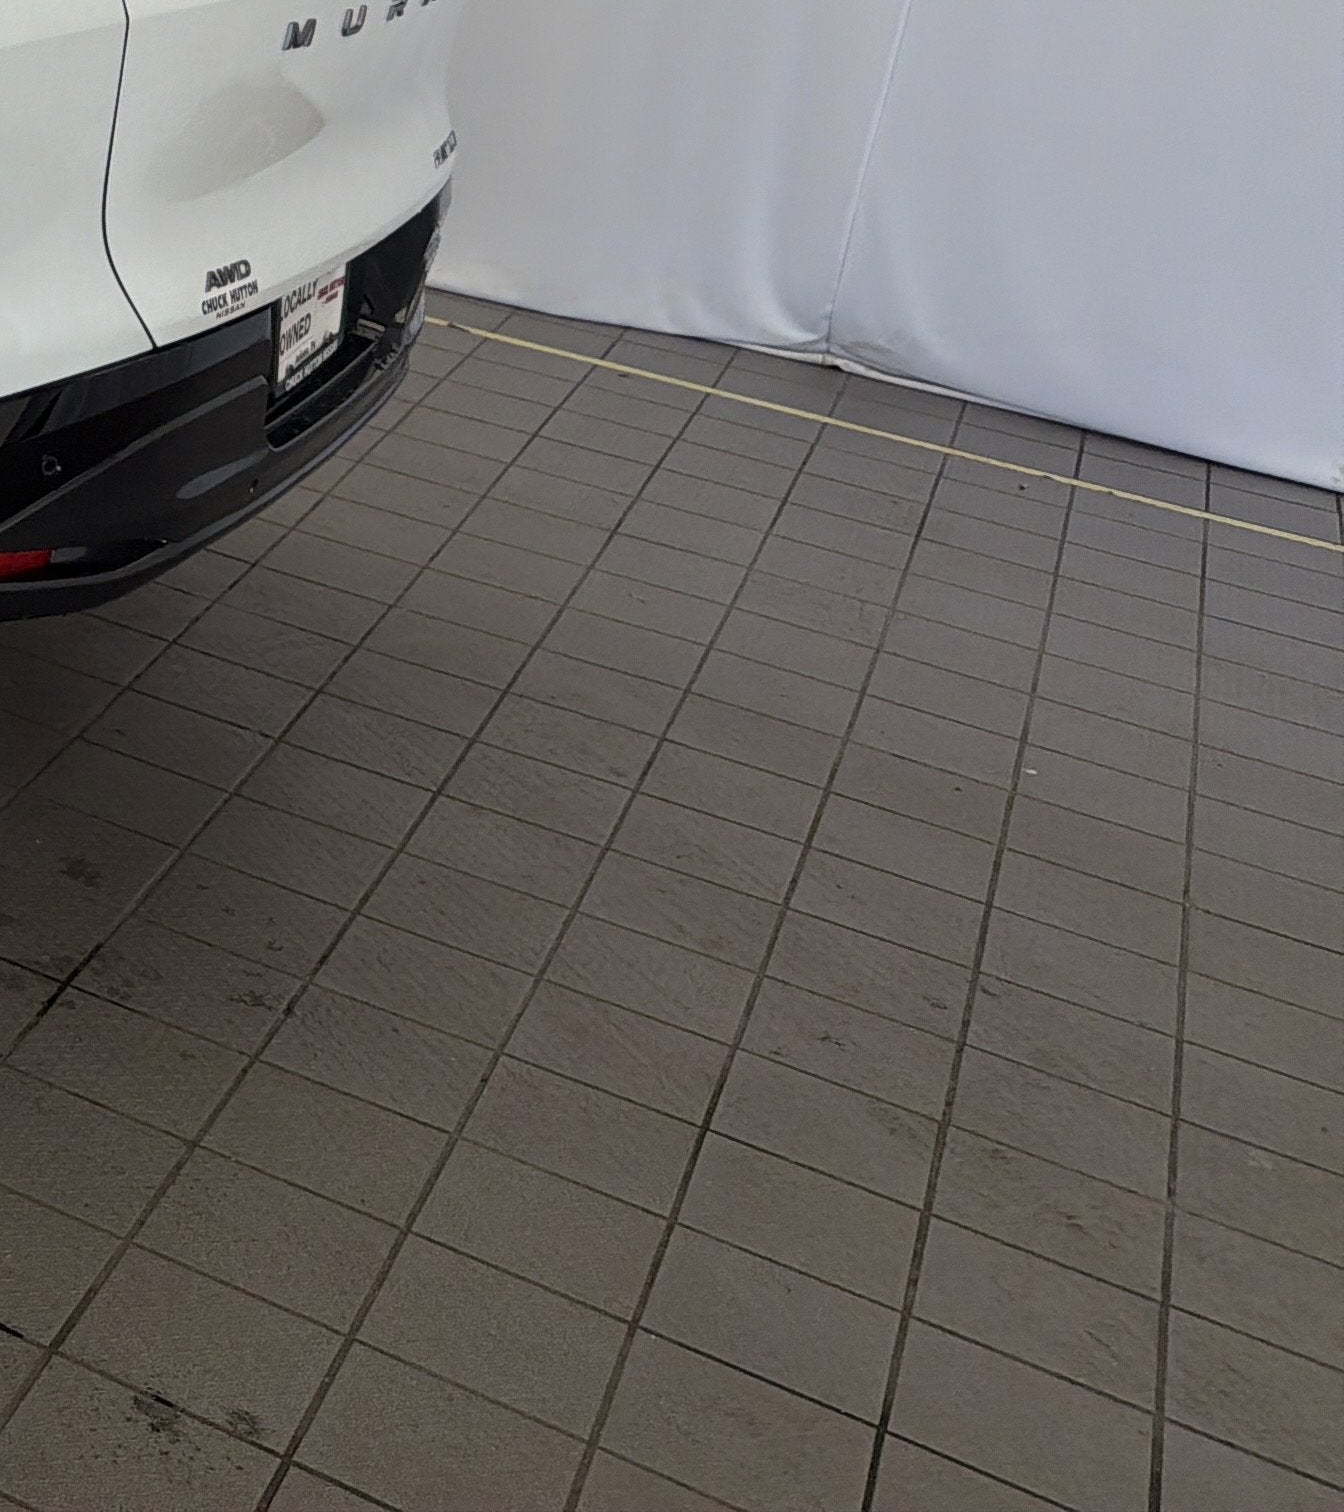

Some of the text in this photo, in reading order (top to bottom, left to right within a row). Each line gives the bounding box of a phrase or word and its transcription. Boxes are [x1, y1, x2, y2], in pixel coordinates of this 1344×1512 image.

[205, 258, 252, 293] AWD
[201, 279, 259, 316] CHUCK HUTTON
[215, 300, 246, 319] NISSAN
[279, 312, 312, 357] OWNED
